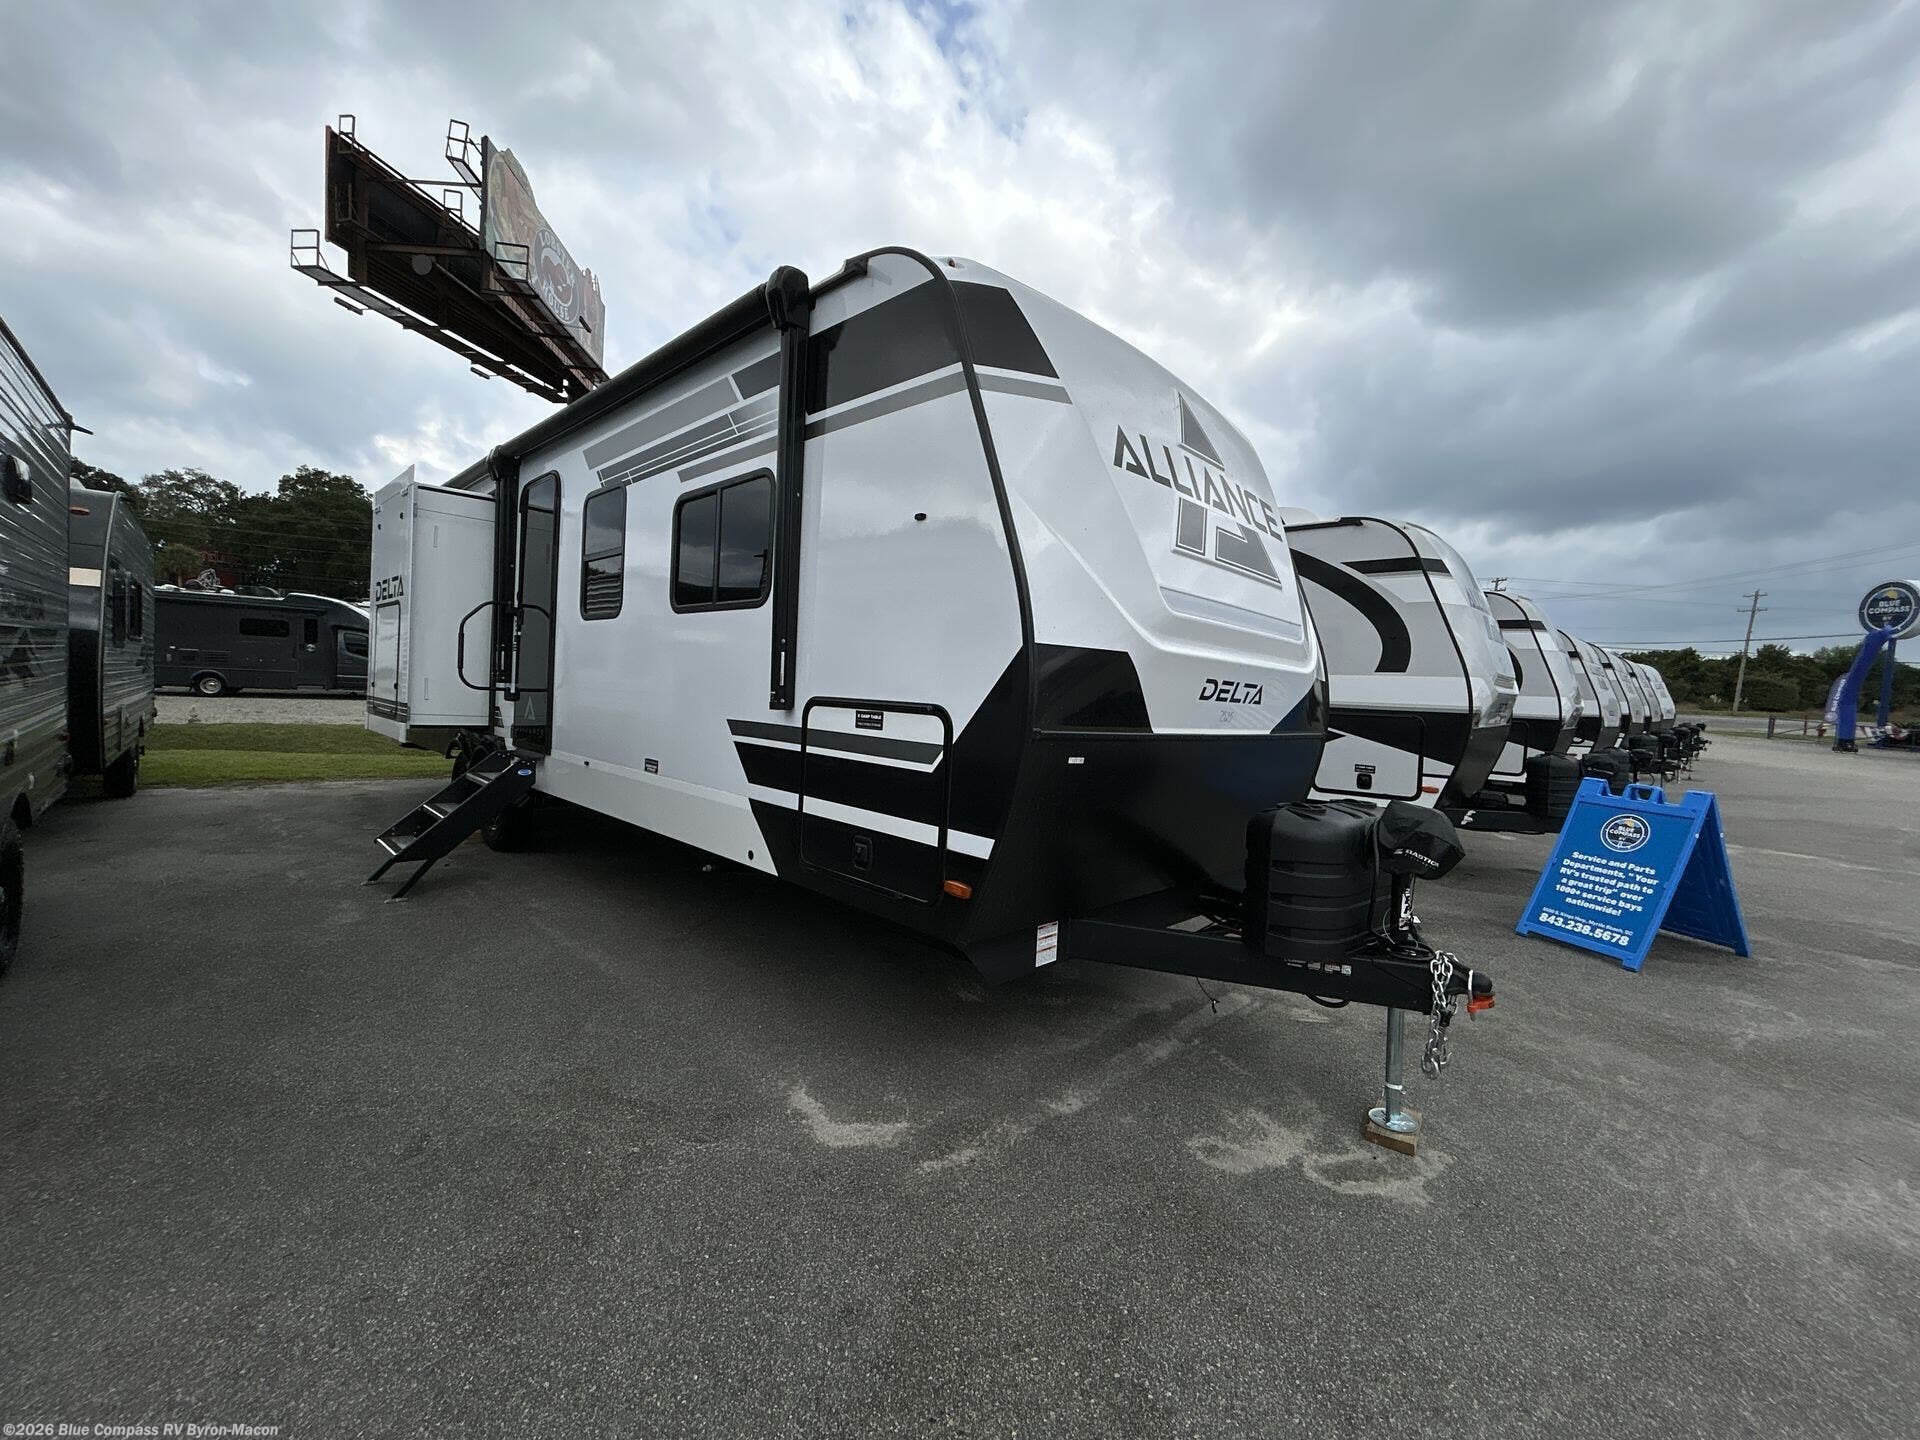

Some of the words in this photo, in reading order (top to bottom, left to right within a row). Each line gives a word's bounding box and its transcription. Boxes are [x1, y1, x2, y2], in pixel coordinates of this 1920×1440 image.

[1113, 424, 1283, 543] ALLIANCE
[375, 574, 404, 602] DELTA
[1869, 605, 1911, 614] COMPASS
[1198, 678, 1264, 705] DELTA
[1609, 829, 1641, 838] COMPASS
[1562, 858, 1626, 879] Departments,
[1635, 874, 1659, 885] Your
[1572, 851, 1607, 865] Service
[1608, 860, 1628, 869] and
[1628, 863, 1656, 875] Parts
[1560, 867, 1580, 877] RV's
[1581, 872, 1617, 886] trusted
[1616, 881, 1641, 891] path
[1642, 886, 1654, 895] to
[1568, 879, 1594, 890] great
[1620, 892, 1644, 902] over
[1555, 884, 1581, 895] 1000+
[1581, 891, 1617, 906] service
[1618, 900, 1643, 912] bays
[1565, 897, 1622, 917] nationwide!
[1538, 912, 1630, 946] 843.238.5678
